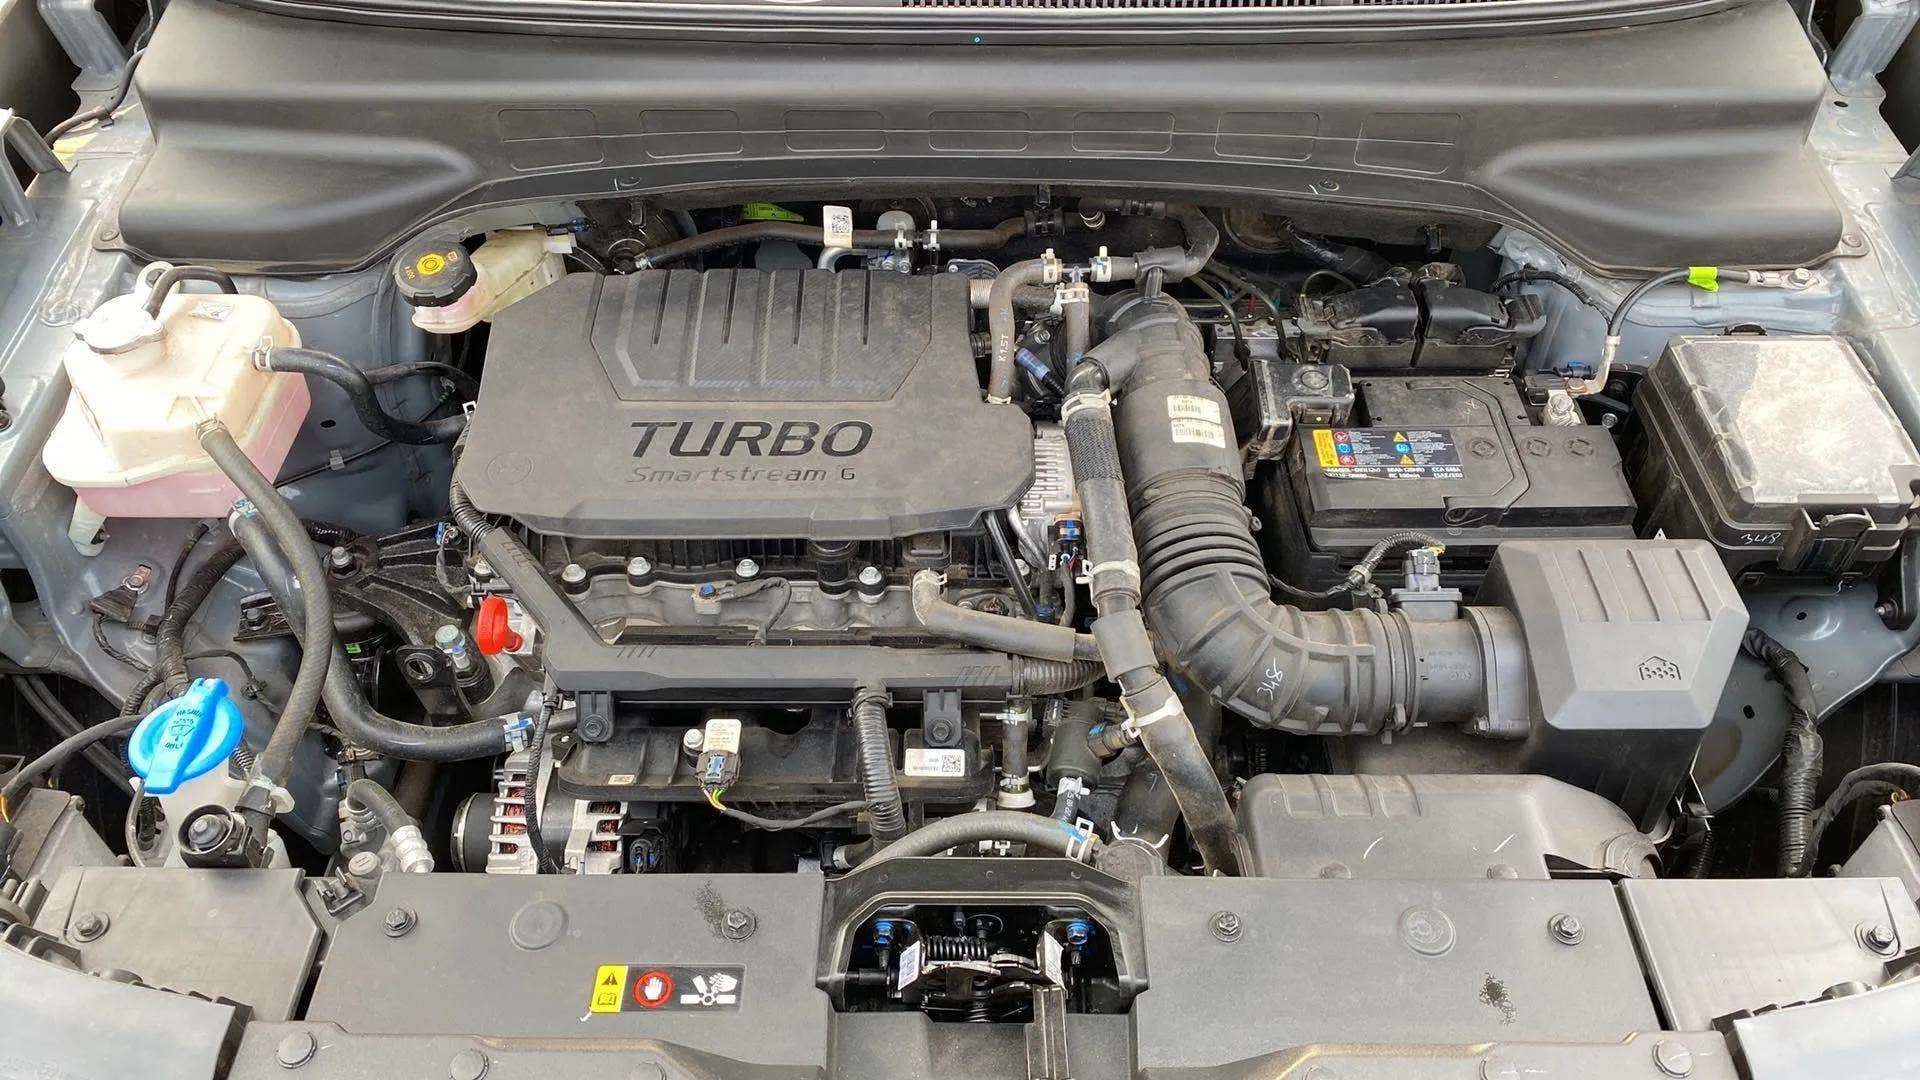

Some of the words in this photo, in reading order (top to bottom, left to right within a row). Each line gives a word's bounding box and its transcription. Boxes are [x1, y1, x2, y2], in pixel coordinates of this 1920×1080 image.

[630, 420, 874, 458] TURBO
[628, 465, 828, 483] Smartstream
[840, 466, 856, 481] G
